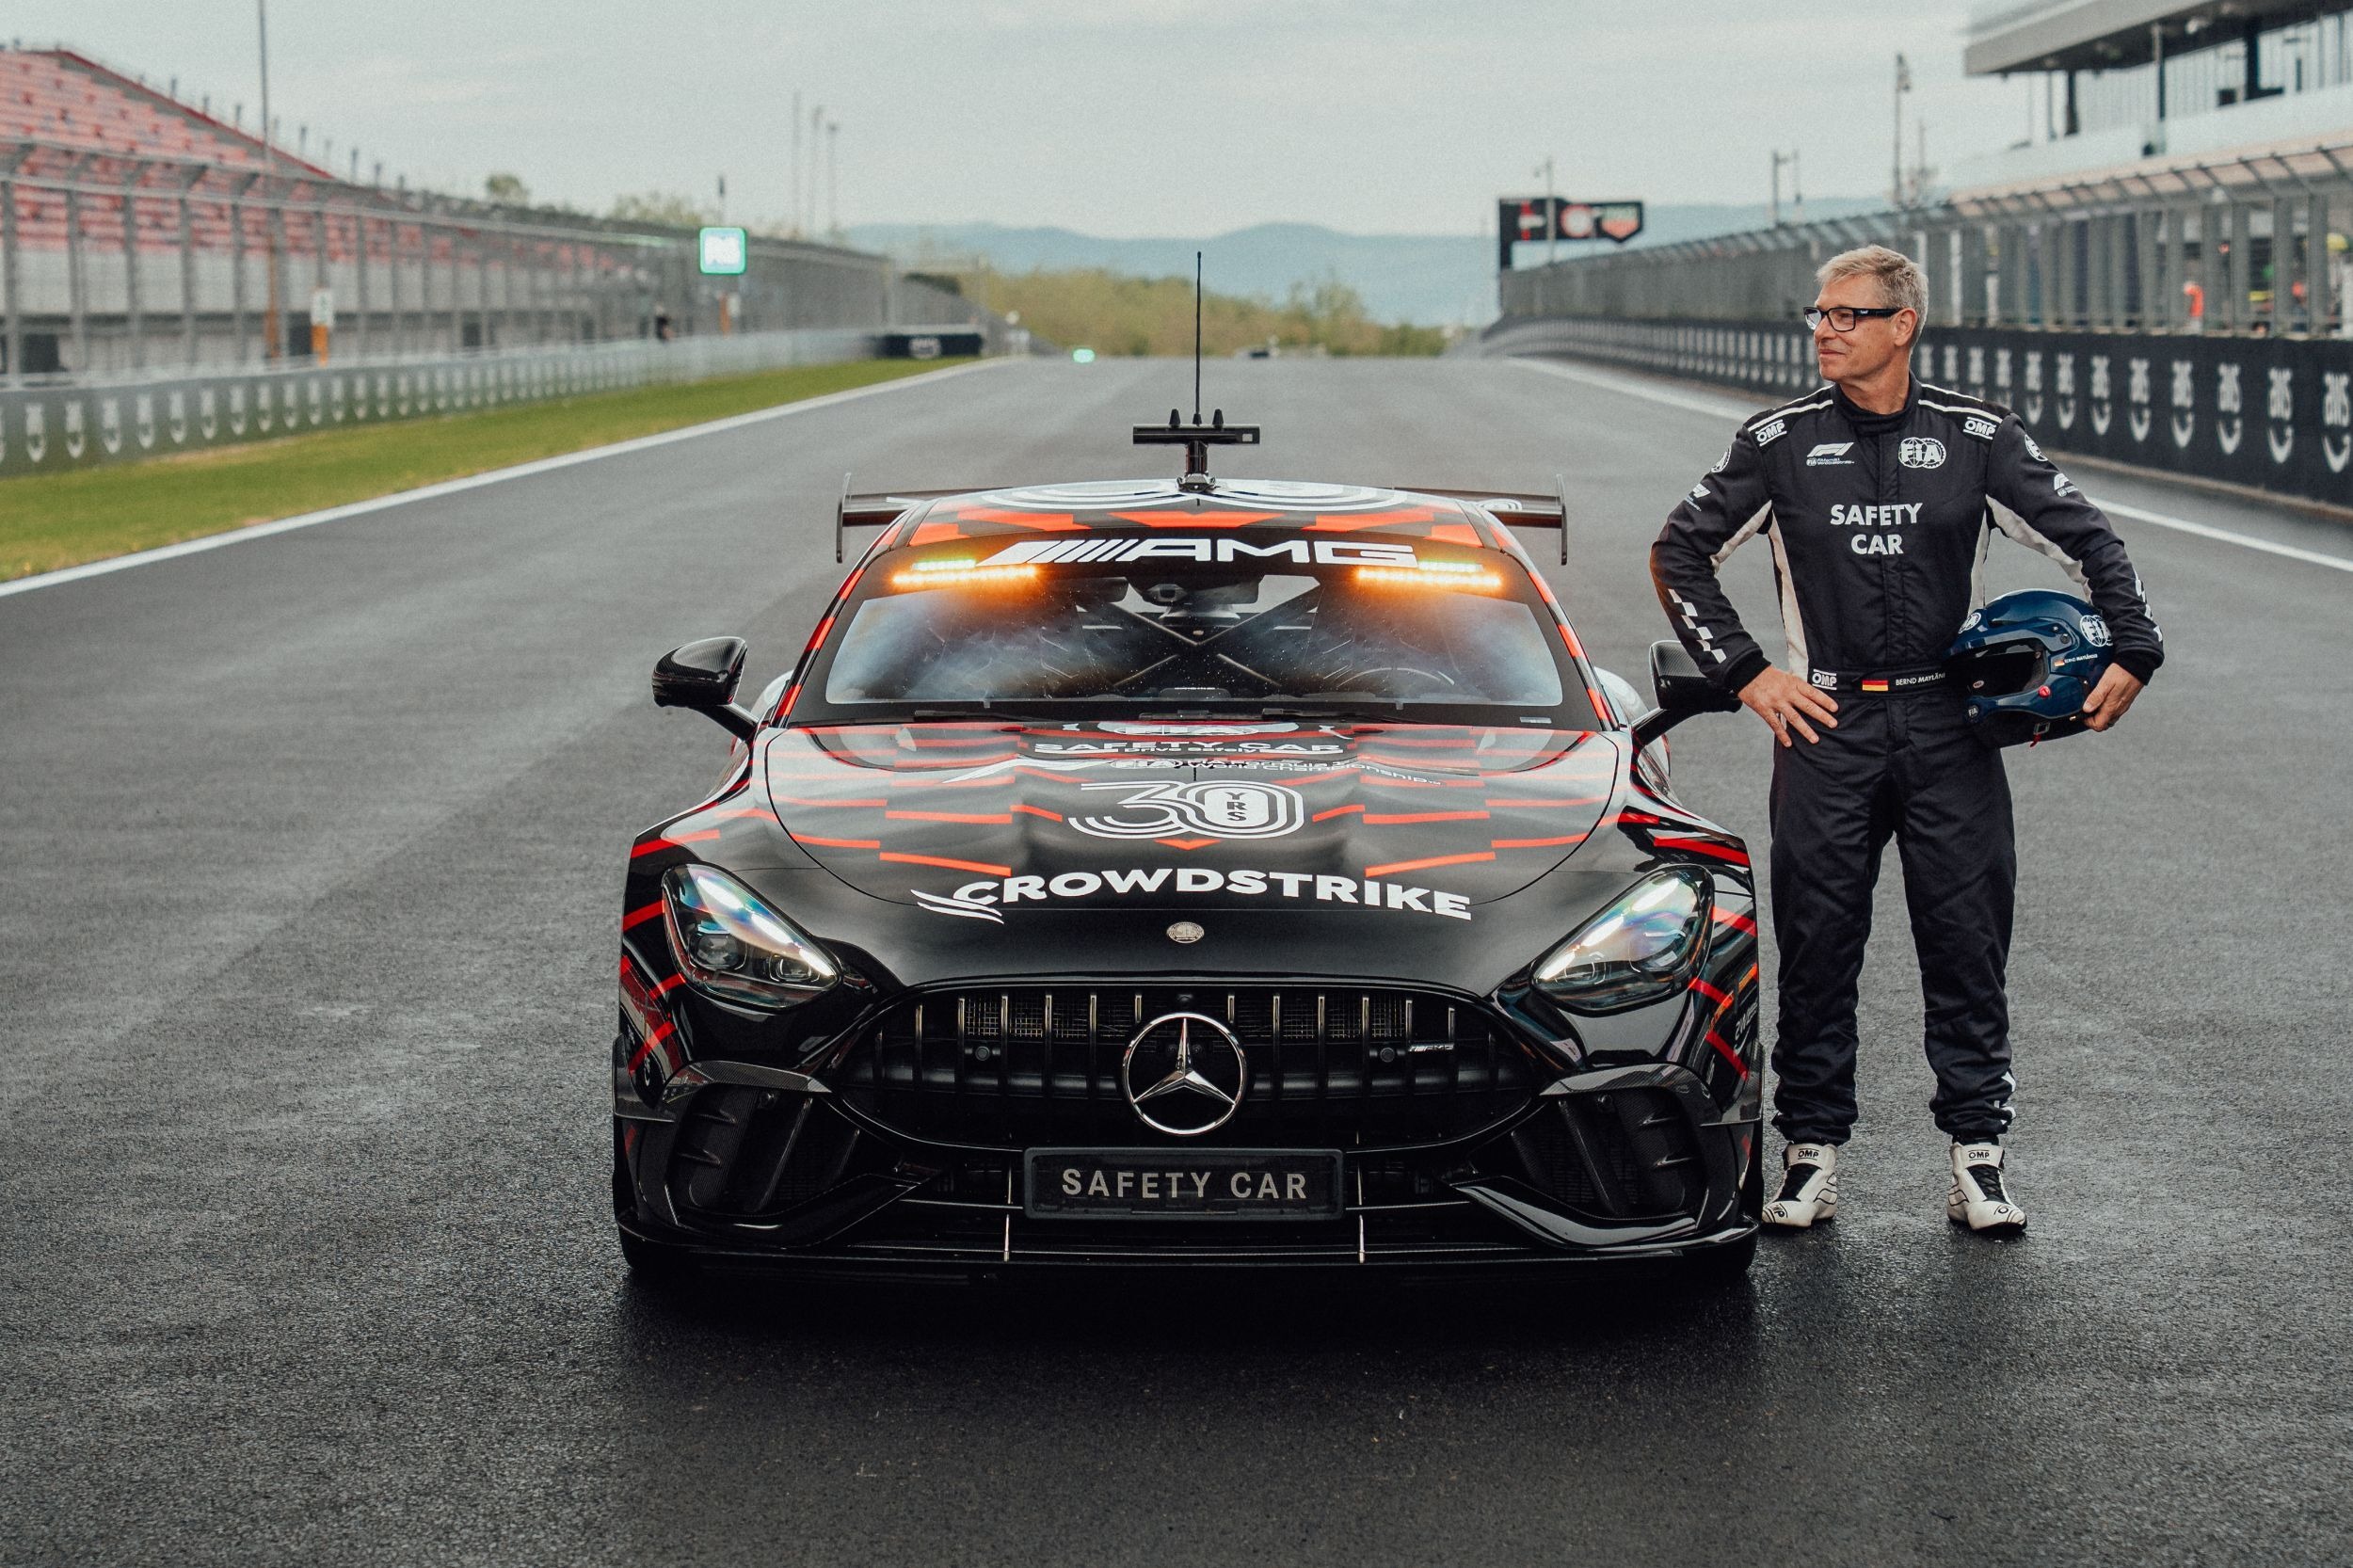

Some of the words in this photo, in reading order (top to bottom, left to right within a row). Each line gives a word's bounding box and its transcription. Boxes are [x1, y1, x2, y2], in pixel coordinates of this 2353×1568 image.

[1757, 422, 1785, 442] OMP
[1964, 420, 1996, 436] OMP
[1831, 503, 1923, 526] SAFETY
[1116, 538, 1418, 567] AMG
[1851, 534, 1904, 555] CAR
[1812, 672, 1837, 687] OMP
[1896, 677, 1916, 686] BERND
[1035, 741, 1223, 751] SAFETY
[1239, 742, 1343, 751] CAR
[1068, 781, 1305, 839] 30
[952, 869, 1472, 920] CROWDSTRIKE
[1062, 1168, 1211, 1199] SAFETY
[1230, 1172, 1307, 1200] CAR
